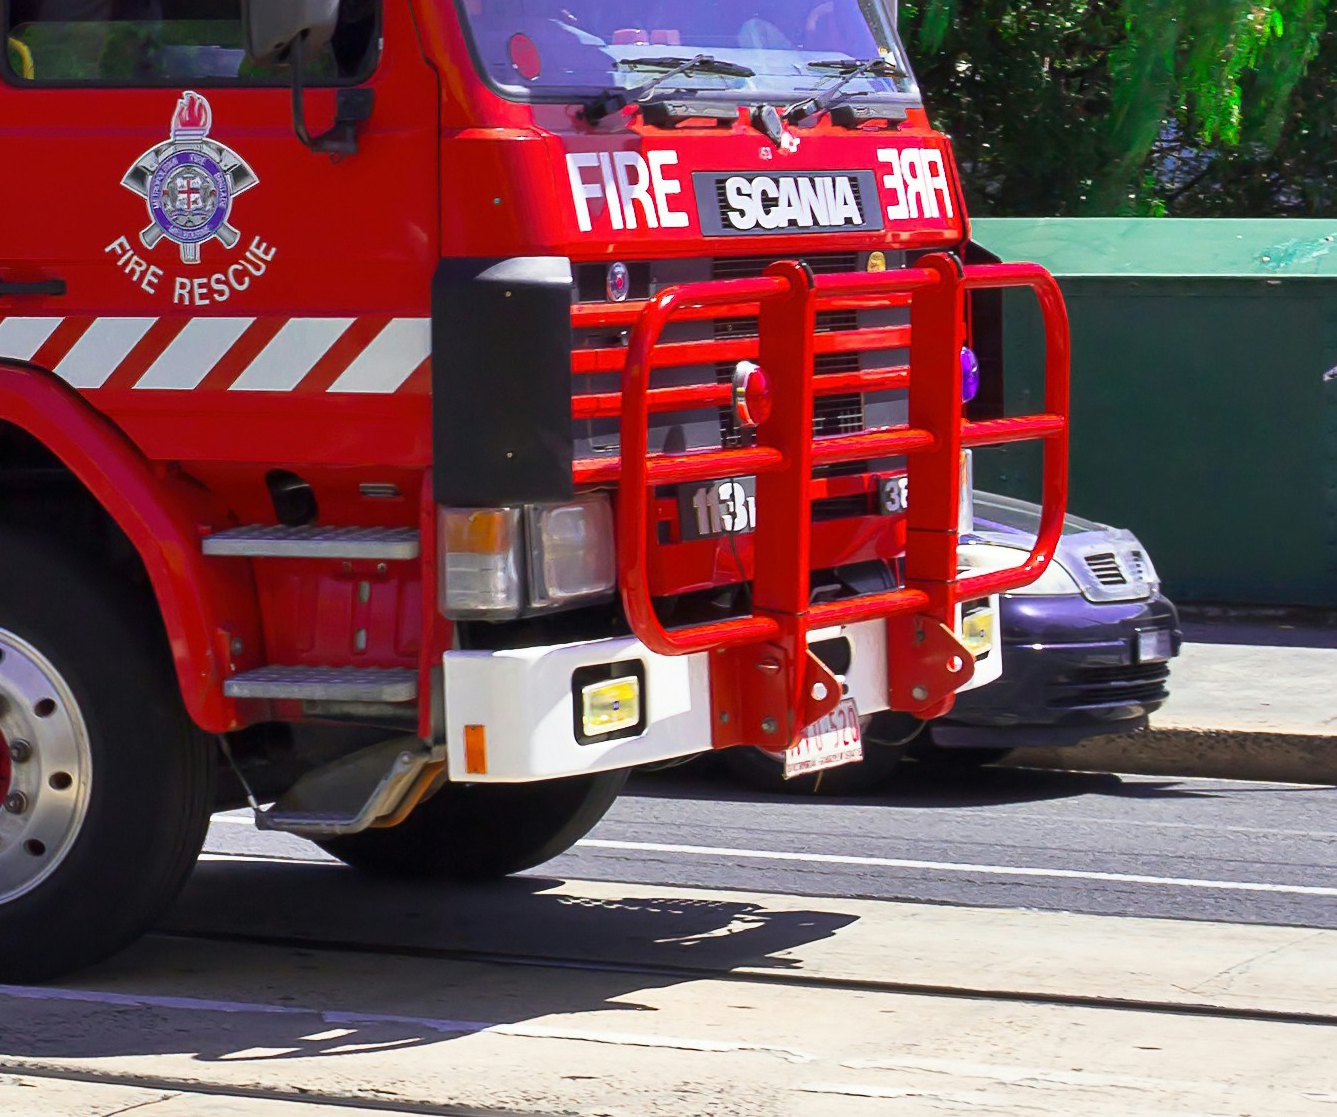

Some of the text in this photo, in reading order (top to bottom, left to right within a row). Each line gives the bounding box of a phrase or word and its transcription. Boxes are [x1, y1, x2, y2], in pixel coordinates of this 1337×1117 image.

[565, 149, 690, 232] FIRE
[725, 176, 865, 230] SCANIA
[104, 235, 277, 306] FIRE RESCUE
